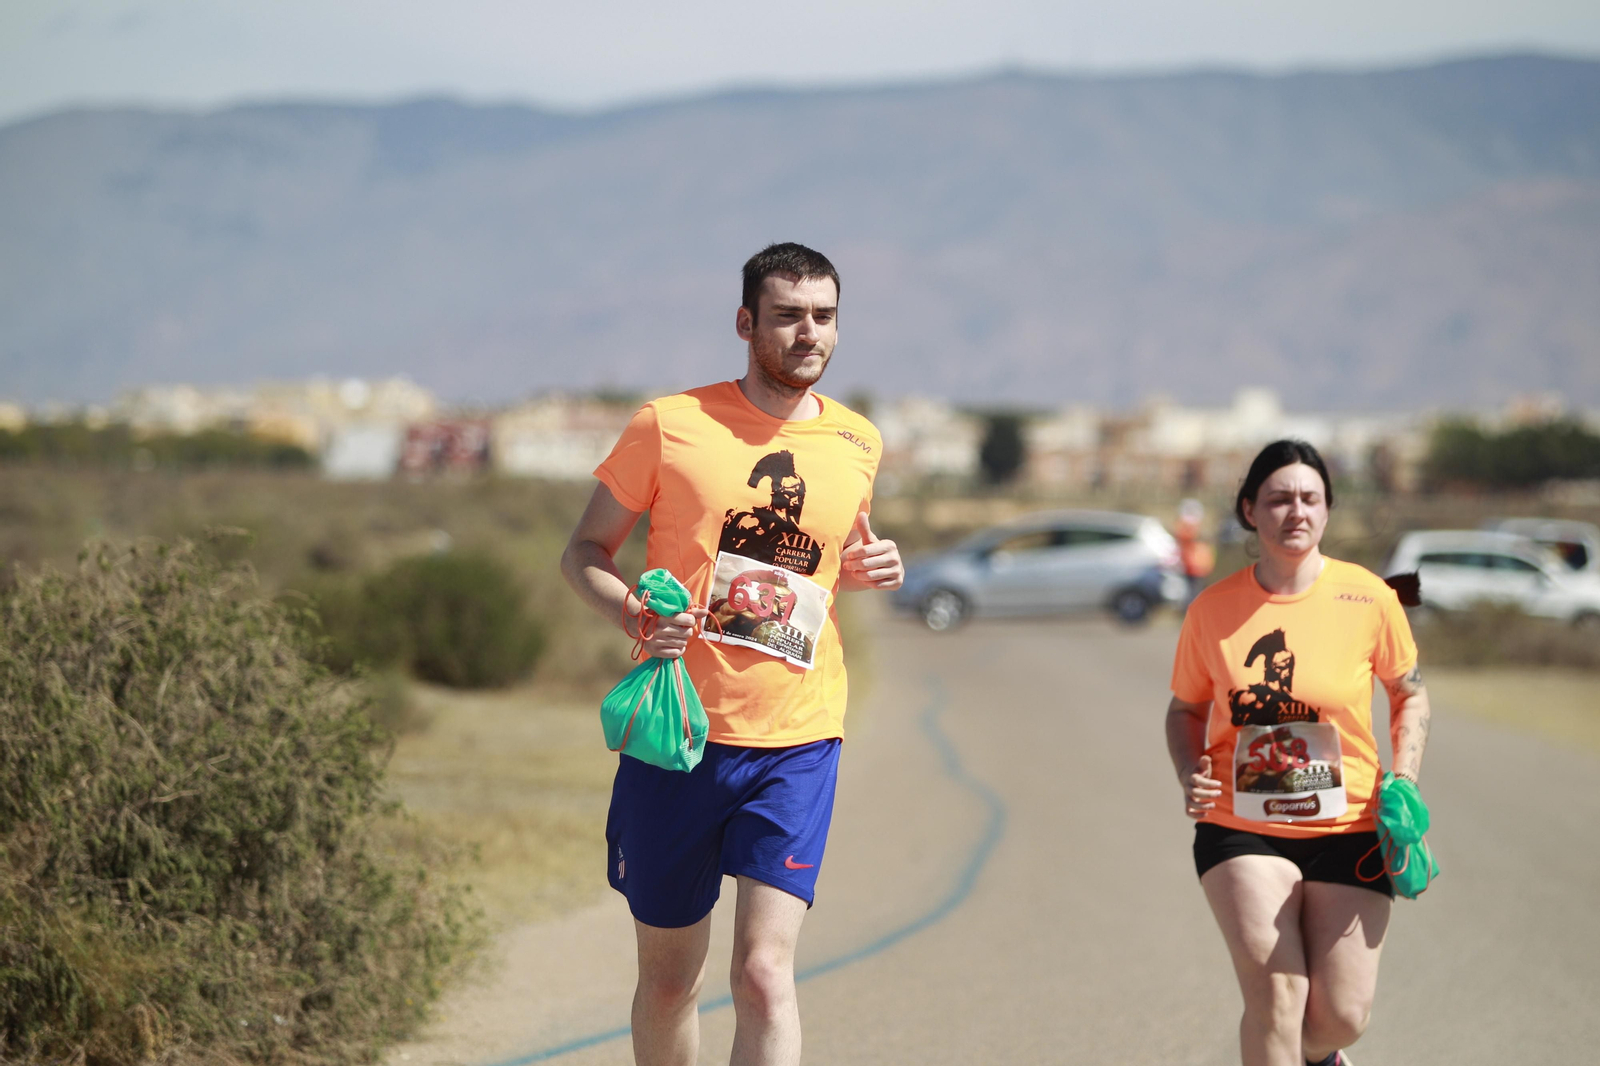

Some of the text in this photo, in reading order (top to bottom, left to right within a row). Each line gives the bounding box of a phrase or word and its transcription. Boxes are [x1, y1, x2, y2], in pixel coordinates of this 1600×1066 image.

[837, 430, 872, 454] JOLUVI
[778, 532, 813, 551] XIII
[774, 556, 809, 568] POPULAR
[775, 547, 811, 560] CARRERA
[728, 574, 797, 626] 631
[770, 629, 805, 648] CARRERA
[771, 620, 806, 643] XIII
[767, 641, 778, 650] DEL
[769, 634, 804, 652] POPULAR
[1278, 701, 1309, 715] XIII
[1249, 737, 1310, 771] 508
